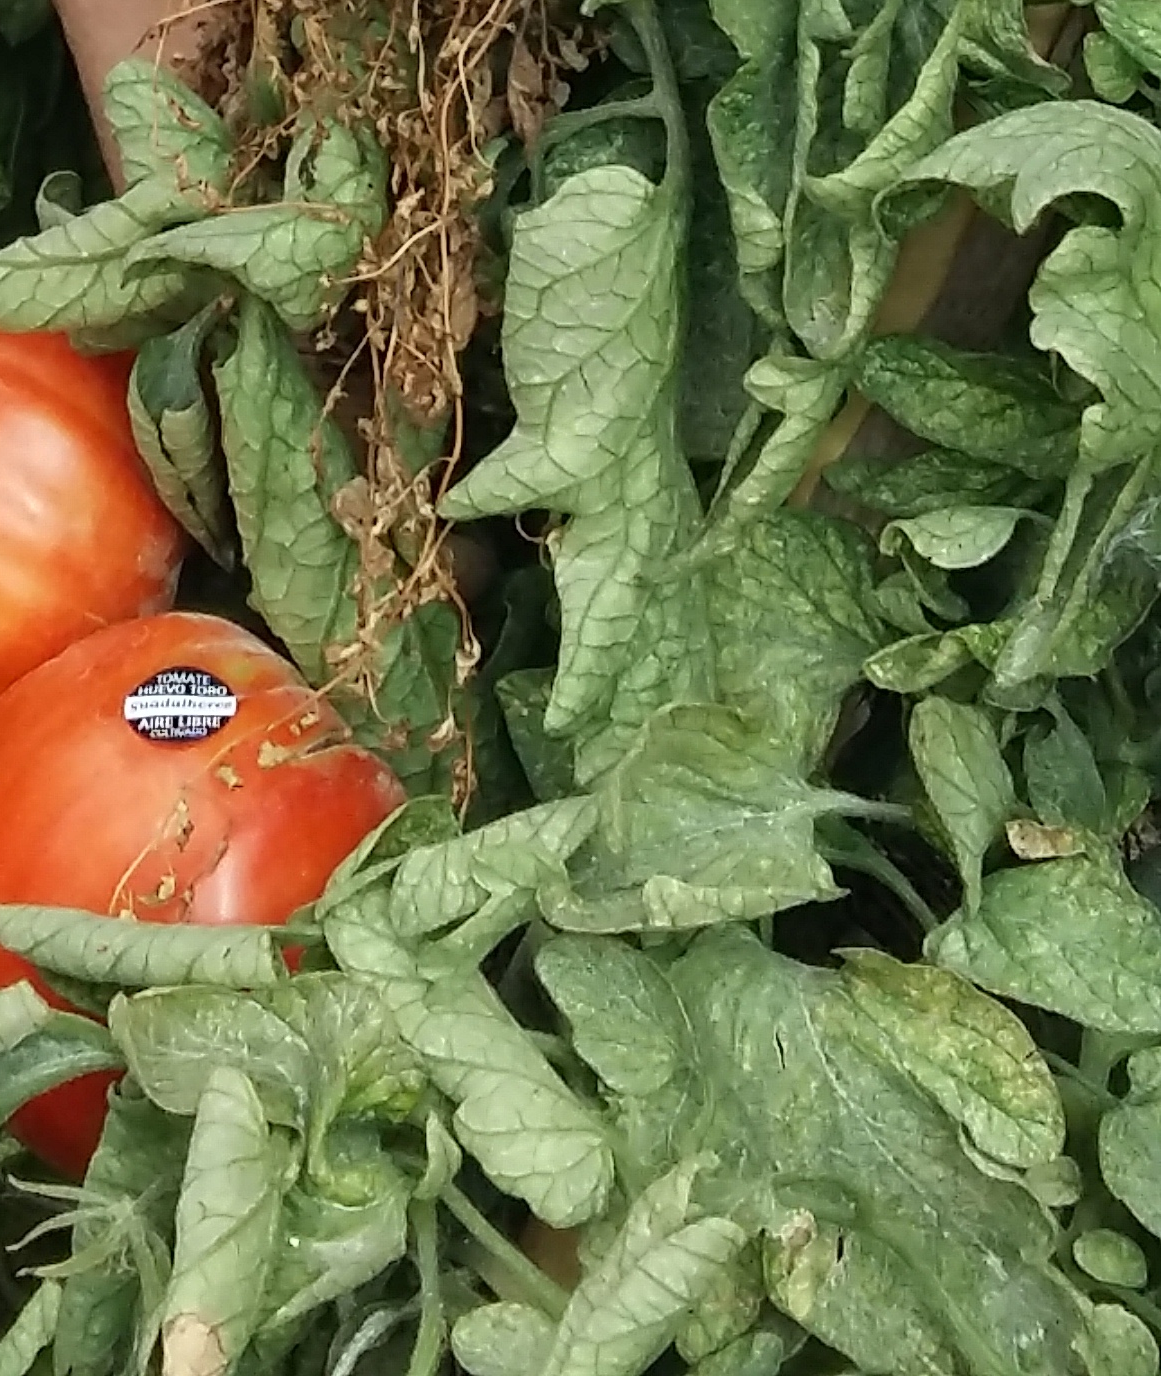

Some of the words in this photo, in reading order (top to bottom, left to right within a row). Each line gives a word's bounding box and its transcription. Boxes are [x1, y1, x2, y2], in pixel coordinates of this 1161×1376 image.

[156, 671, 211, 685] TOMATE
[189, 685, 228, 696] TORO
[138, 716, 173, 730] AIRE
[179, 716, 221, 728] LIBRE
